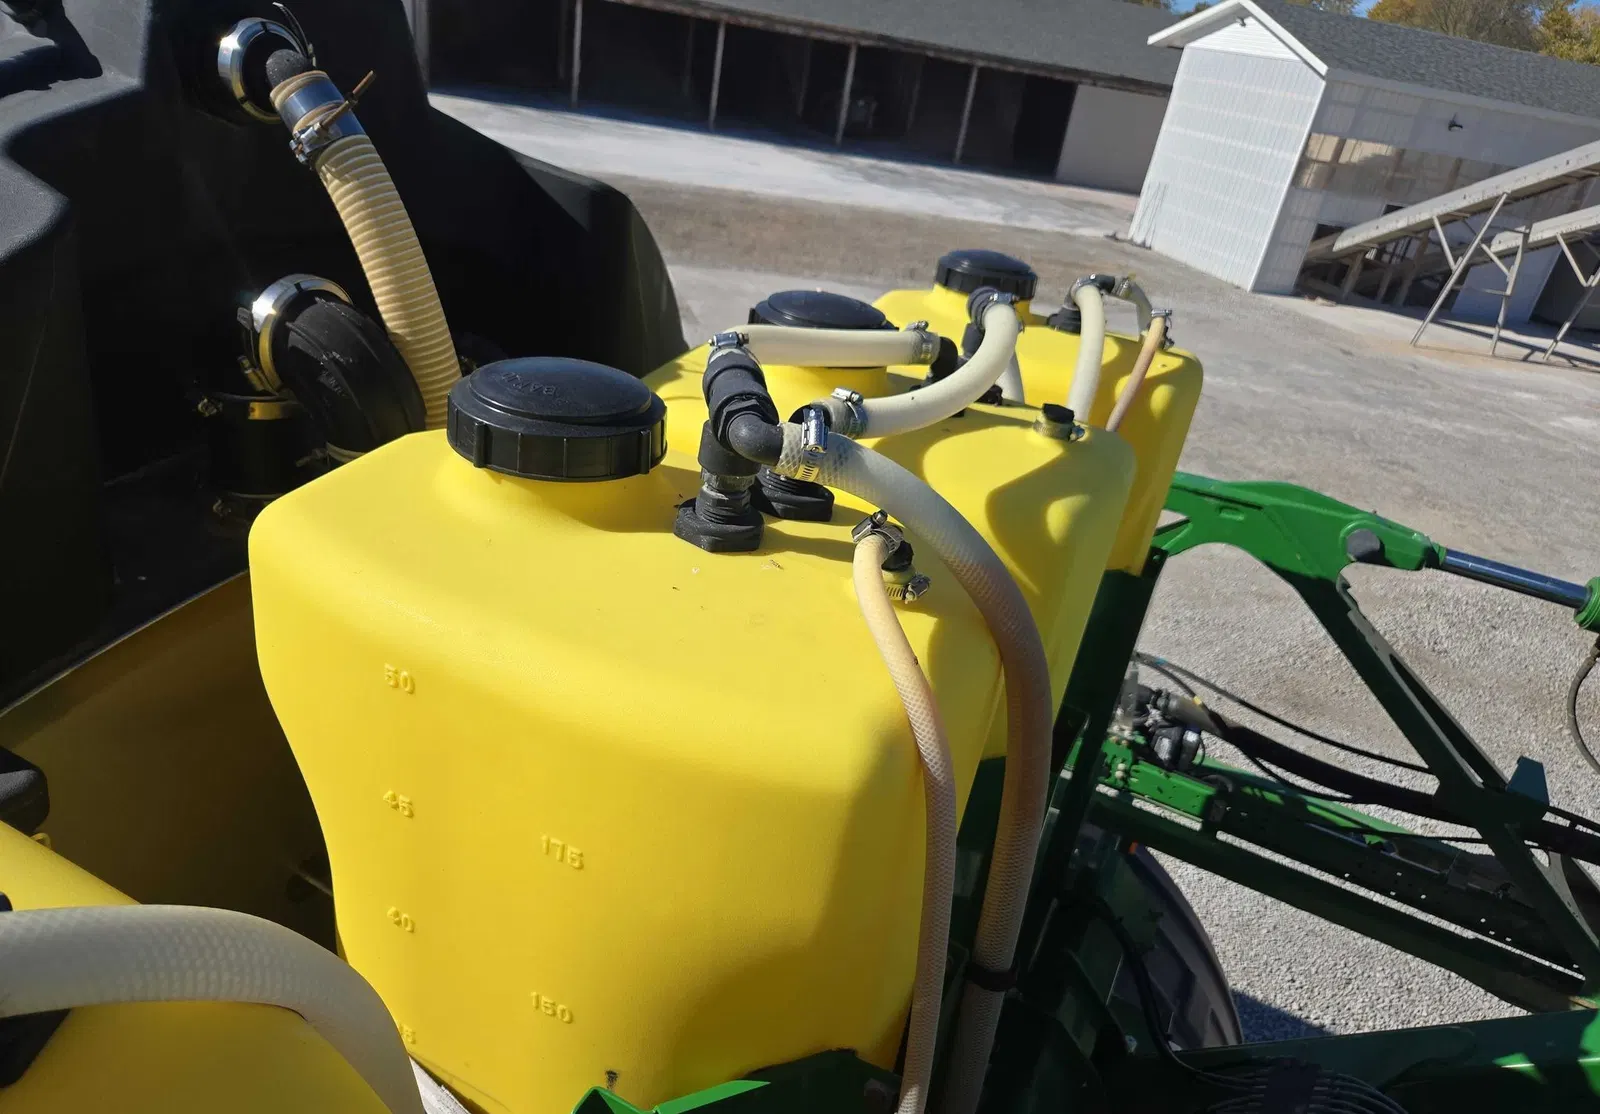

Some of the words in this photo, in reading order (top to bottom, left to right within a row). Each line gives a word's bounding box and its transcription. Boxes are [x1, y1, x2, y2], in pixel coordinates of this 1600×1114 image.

[384, 662, 416, 695] 50
[383, 789, 414, 819] 45
[540, 833, 585, 870] 175
[531, 991, 574, 1024] 150
